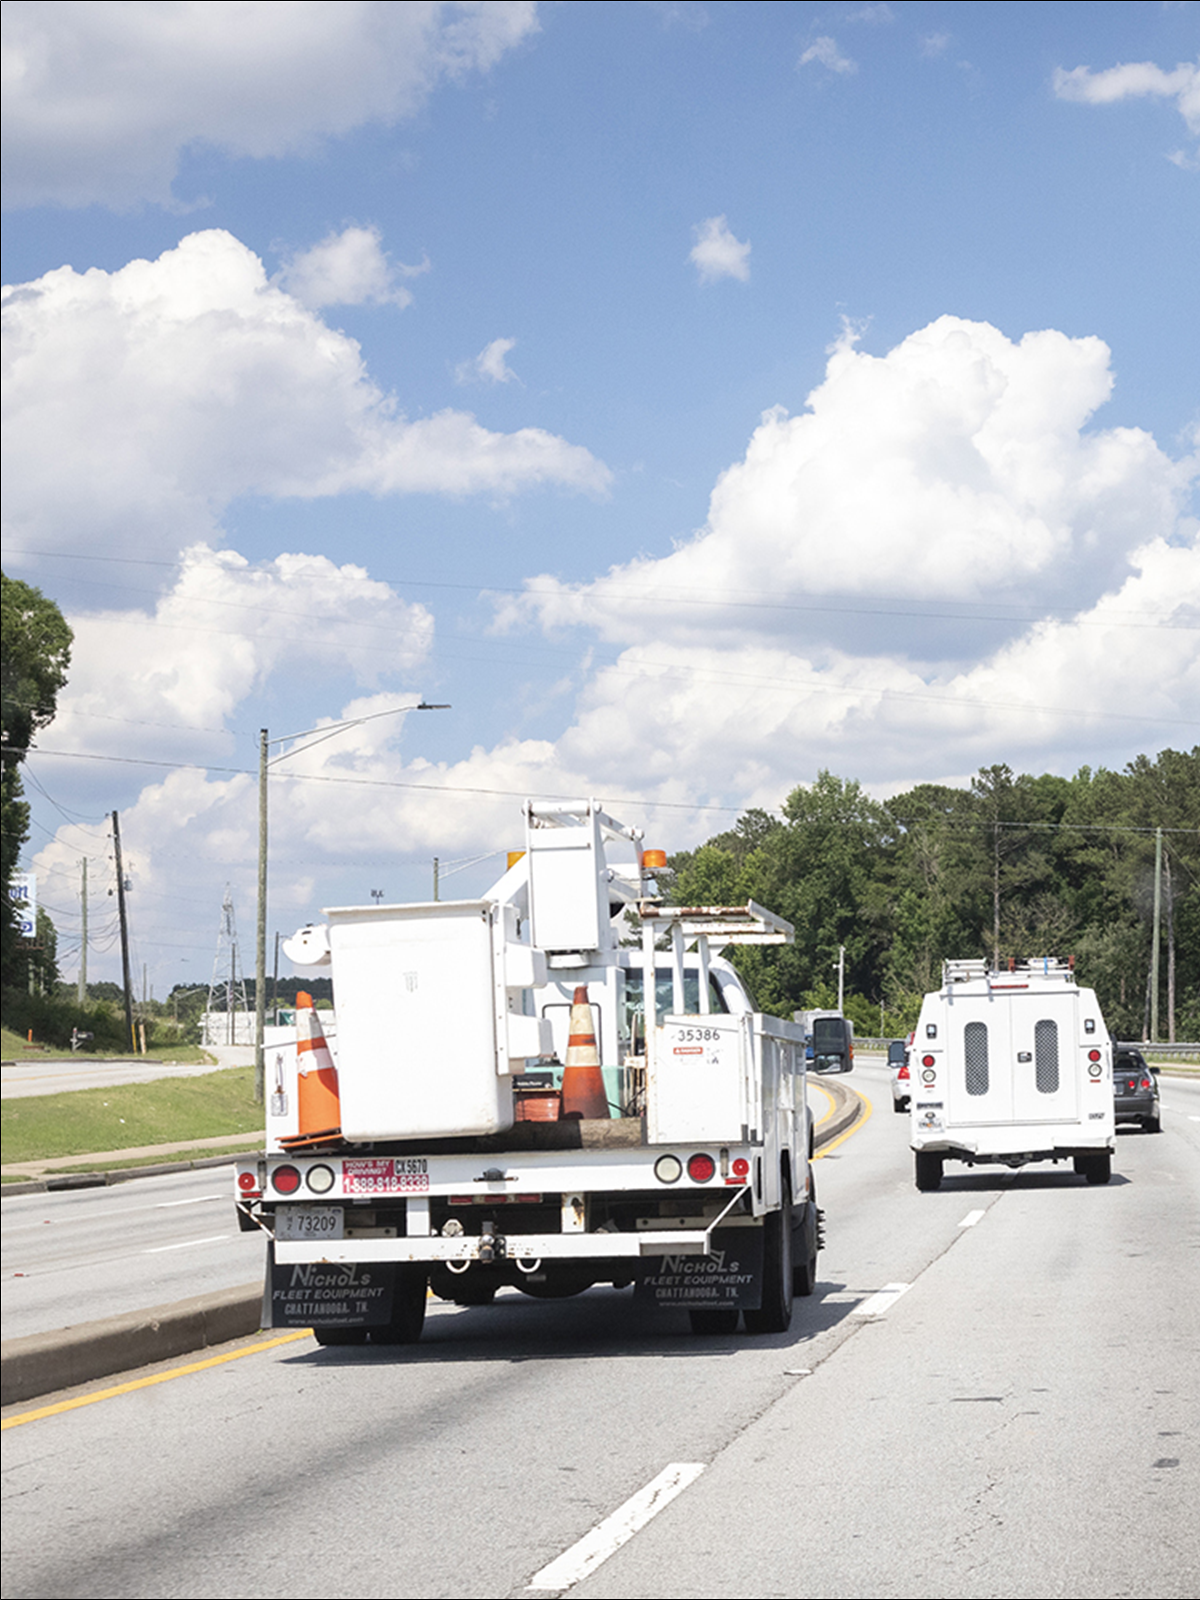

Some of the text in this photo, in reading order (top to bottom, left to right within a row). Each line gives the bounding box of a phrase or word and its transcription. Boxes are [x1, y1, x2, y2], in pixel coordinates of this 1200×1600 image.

[678, 1029, 720, 1042] 35386
[298, 1216, 336, 1231] 73209
[644, 1275, 753, 1285] FLEET EQUIPMENT
[273, 1287, 384, 1300] FLEET EQUIPMENT
